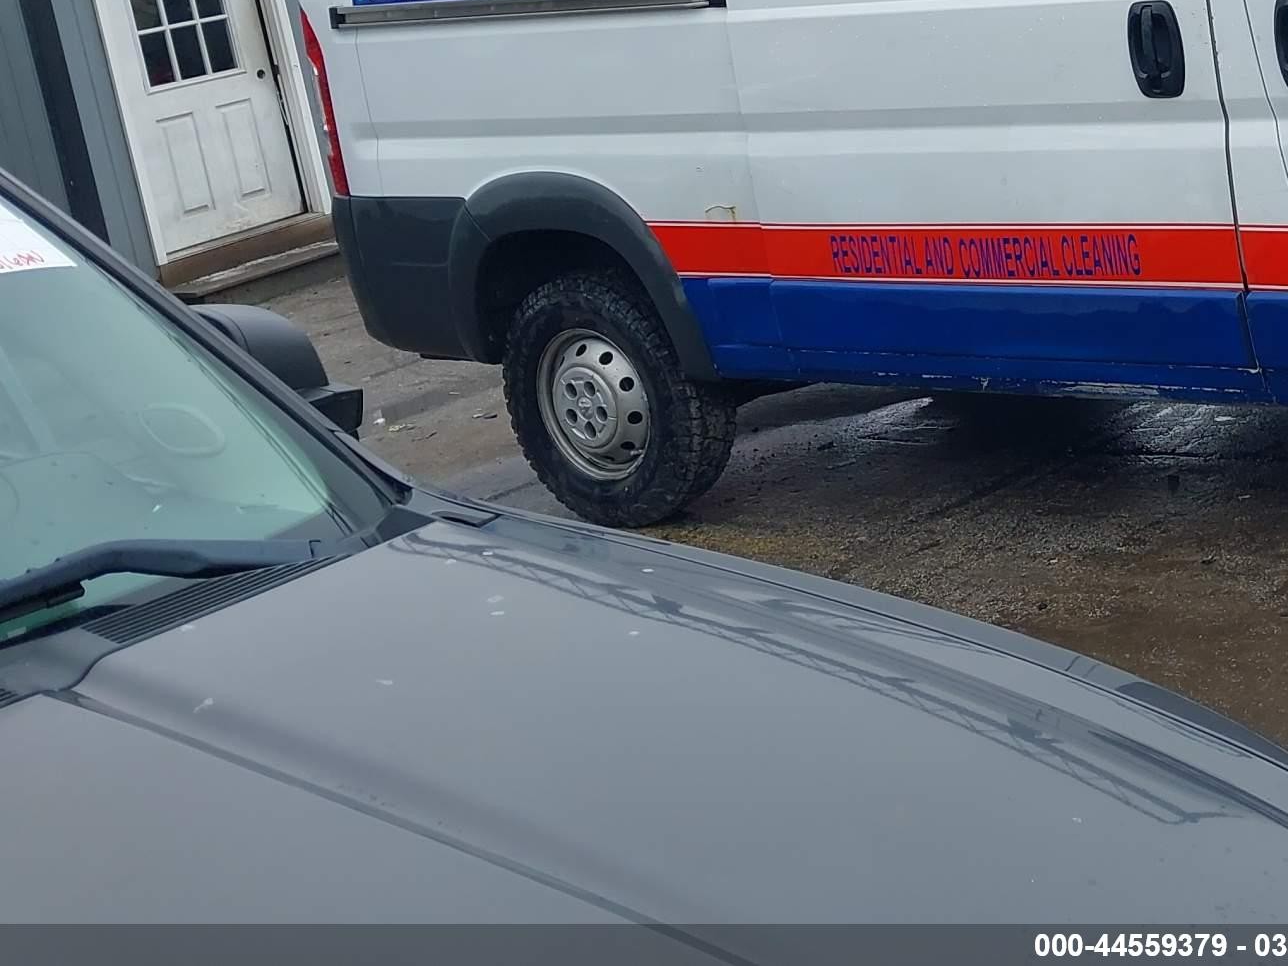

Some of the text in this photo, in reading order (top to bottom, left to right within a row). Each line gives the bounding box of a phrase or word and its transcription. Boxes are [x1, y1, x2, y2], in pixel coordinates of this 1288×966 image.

[830, 234, 1142, 278] RESIDENTIAL AND COMMERCIAL CLEANING
